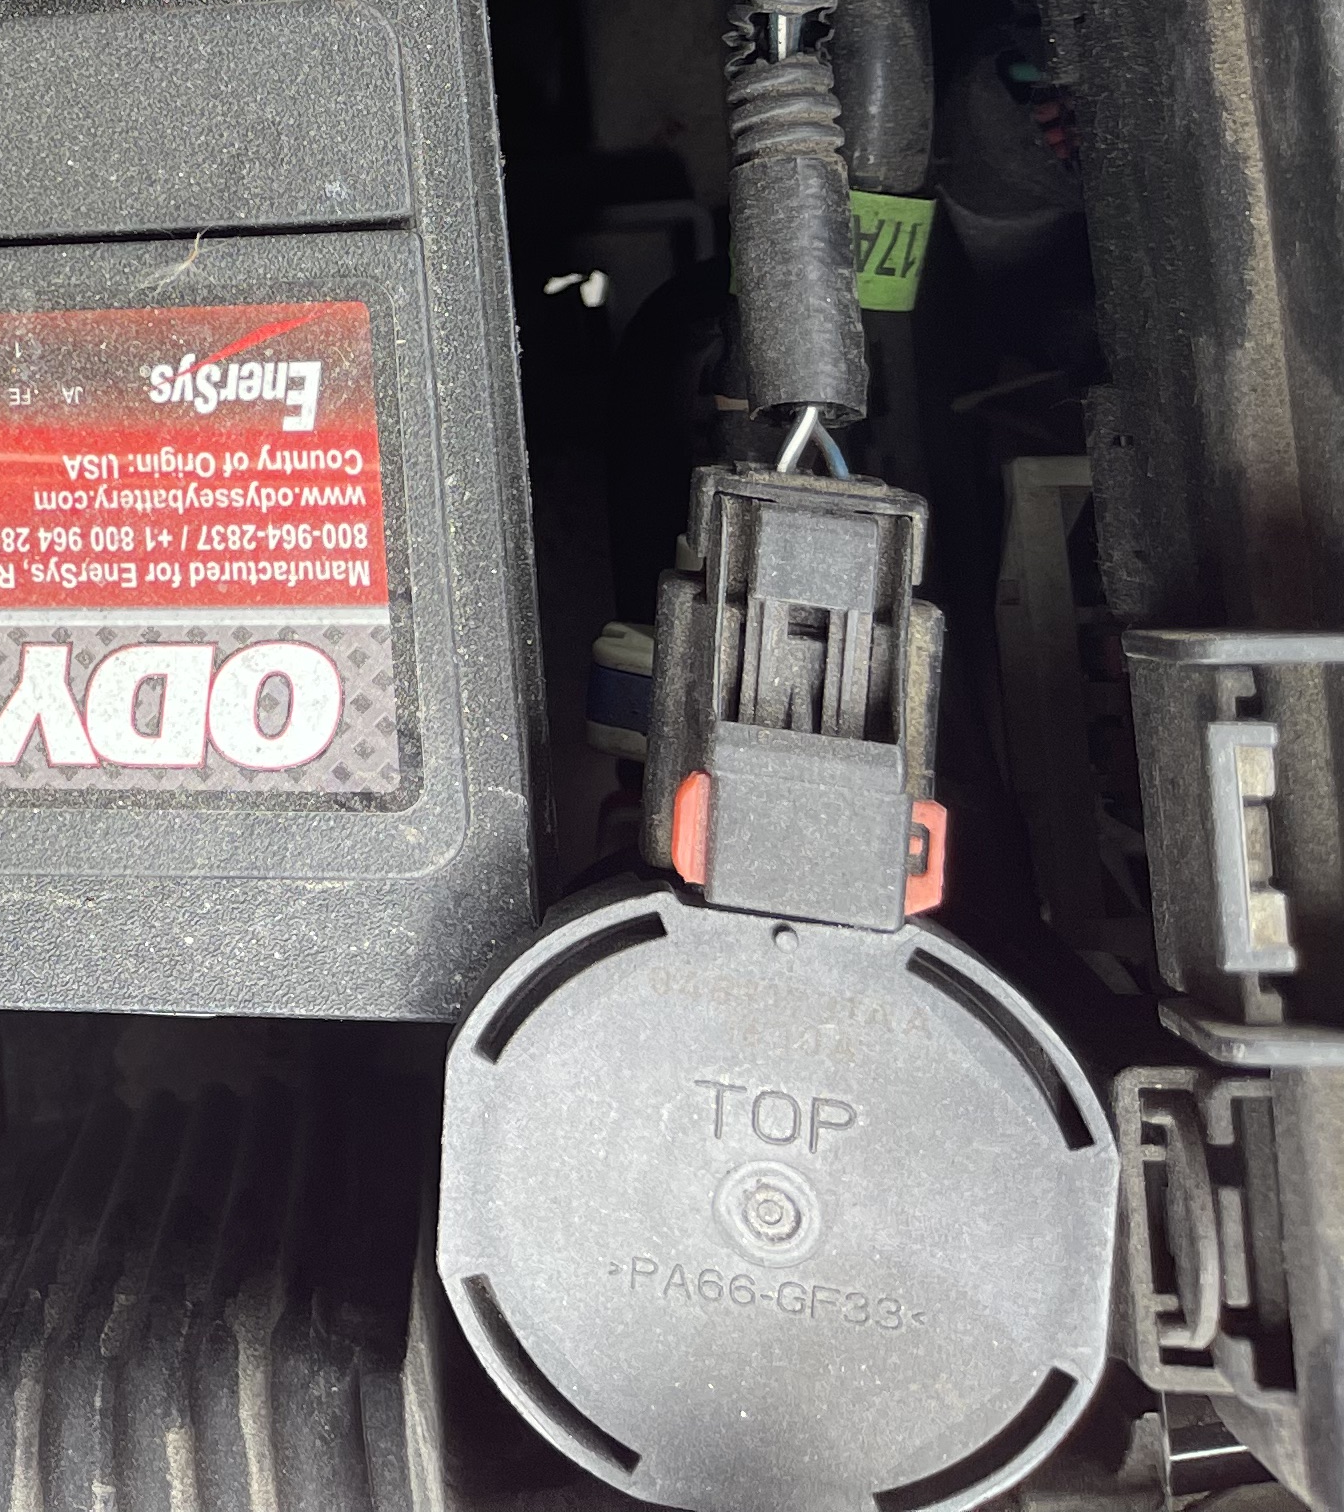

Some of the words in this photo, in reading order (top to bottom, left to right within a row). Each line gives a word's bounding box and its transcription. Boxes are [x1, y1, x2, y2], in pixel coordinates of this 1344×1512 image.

[8, 387, 32, 406] FE
[61, 453, 119, 482] USA
[127, 446, 216, 479] Origin:
[222, 451, 250, 478] of
[256, 444, 363, 477] Country
[33, 480, 367, 516] www.odysseybattery.com
[37, 526, 83, 554] 964
[89, 525, 135, 553] 800
[144, 525, 174, 553] +1
[196, 522, 368, 552] 800-964-2837
[22, 556, 138, 590] EnerSys,
[144, 561, 182, 589] for
[188, 559, 371, 588] Manufactured
[693, 1079, 858, 1155] TOP
